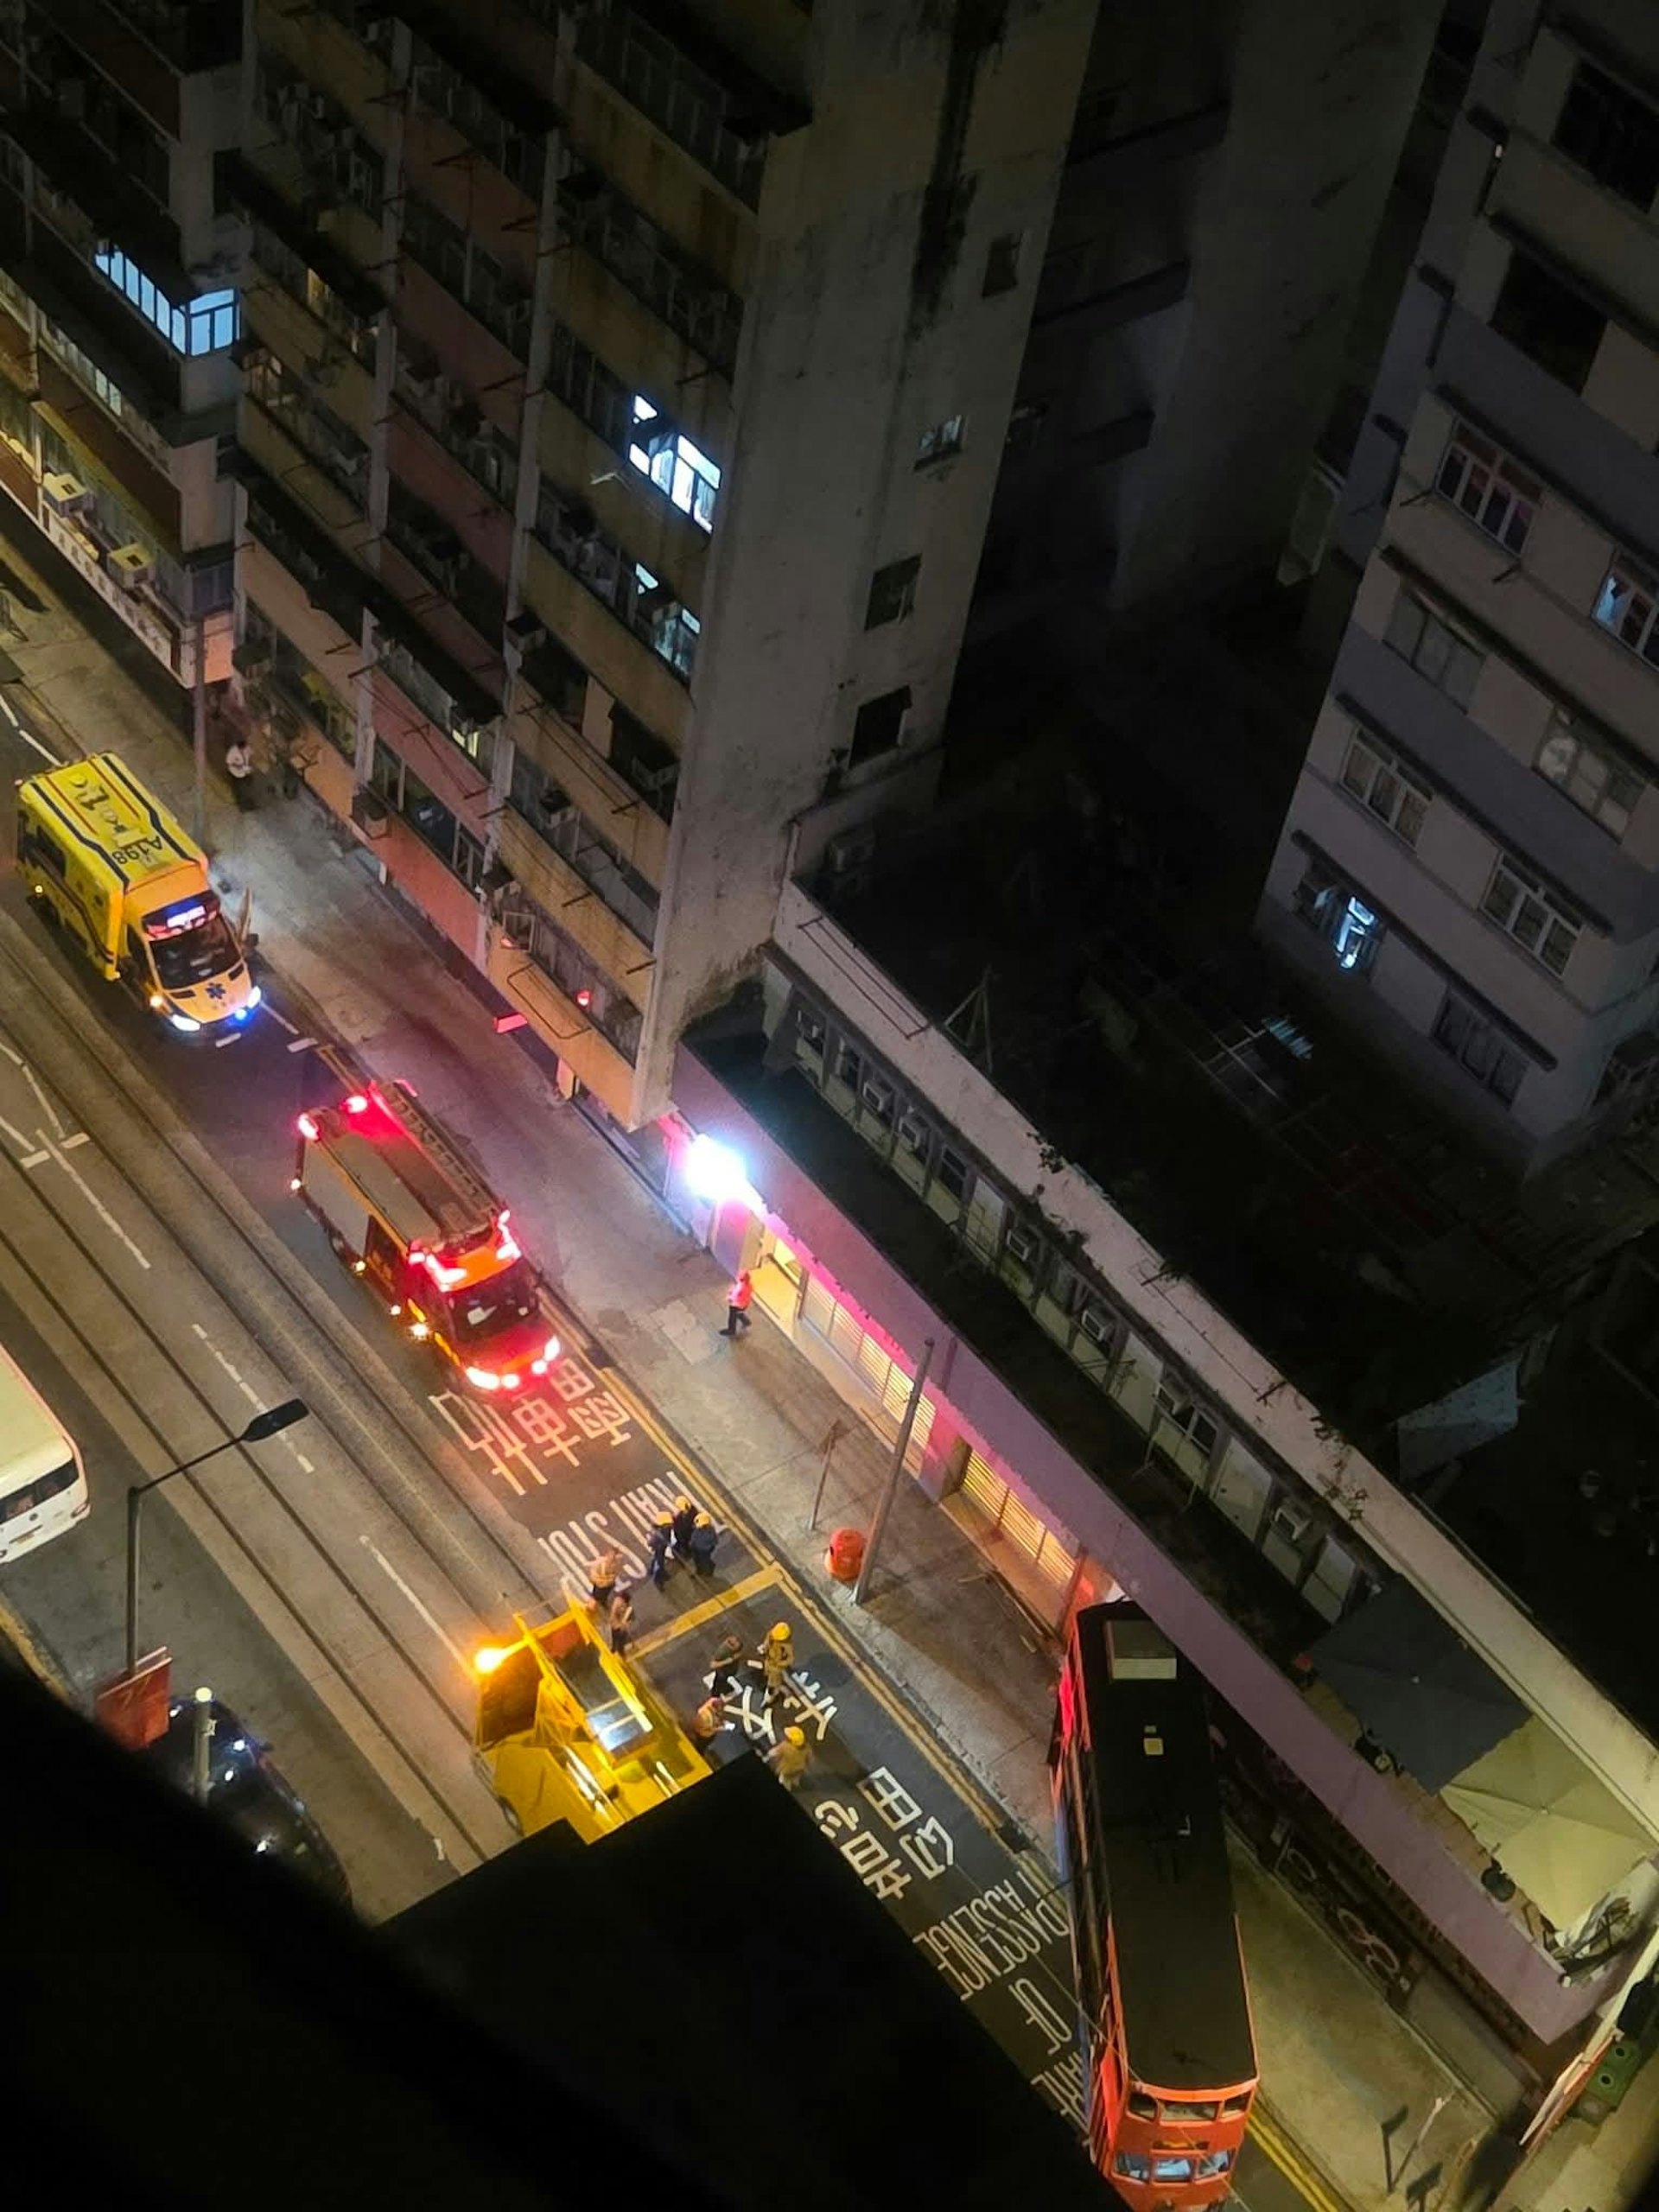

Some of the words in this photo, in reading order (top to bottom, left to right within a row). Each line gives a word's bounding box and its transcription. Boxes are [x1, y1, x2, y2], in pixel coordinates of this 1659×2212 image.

[112, 836, 164, 865] A198
[537, 1511, 647, 1600] STOP
[609, 1471, 728, 1556] TRAM
[814, 1767, 954, 1900] 留意
[1008, 1978, 1072, 2056] OF
[1031, 2051, 1090, 2147] ARE
